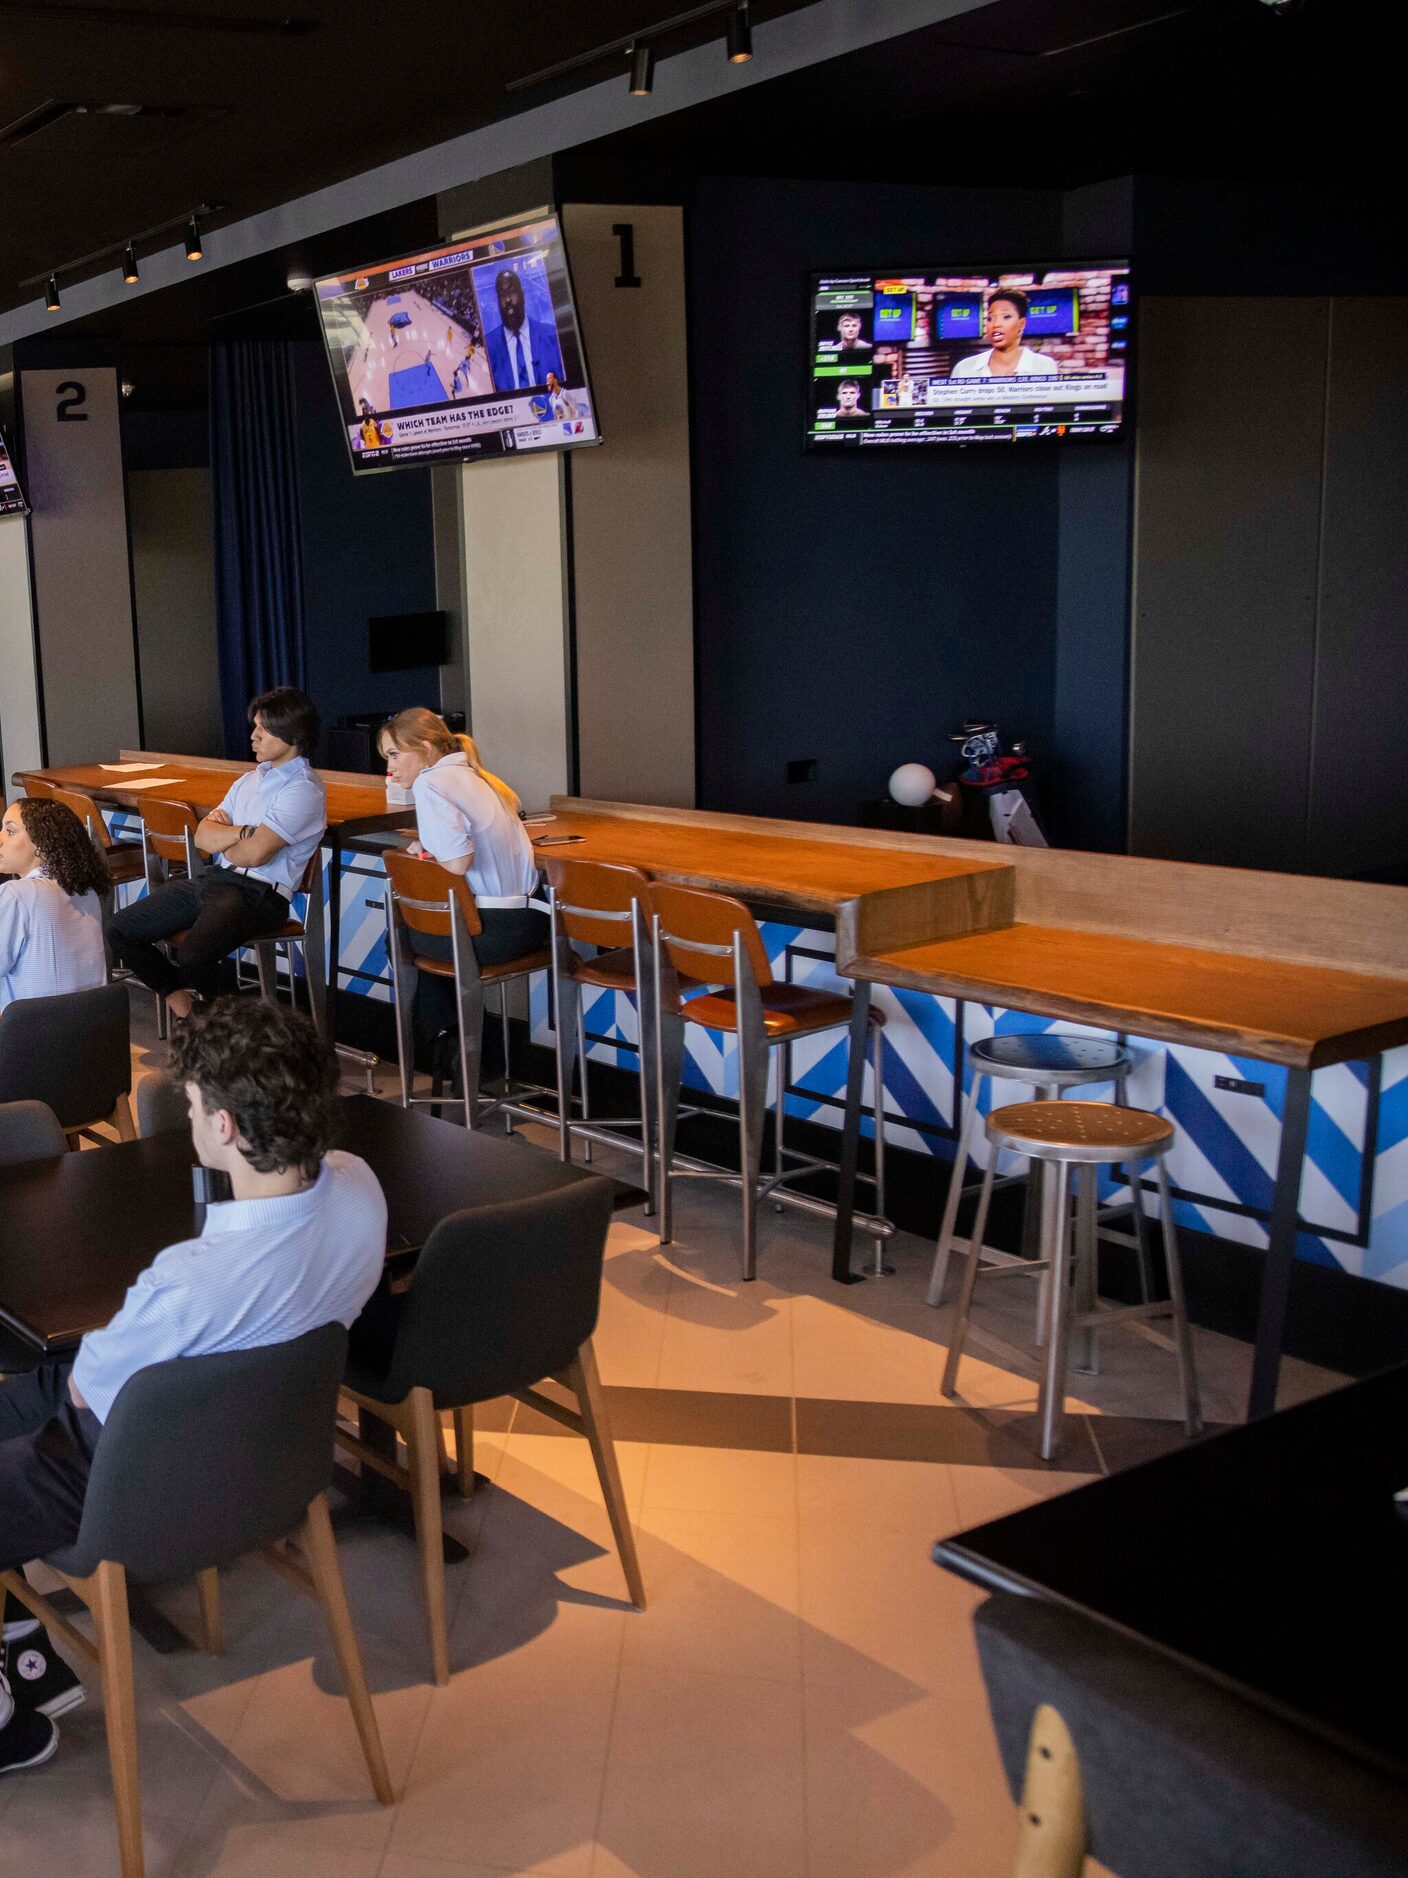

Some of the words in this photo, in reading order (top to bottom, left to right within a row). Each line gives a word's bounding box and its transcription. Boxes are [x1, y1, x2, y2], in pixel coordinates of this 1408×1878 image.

[391, 267, 413, 279] LAKERS
[431, 252, 471, 268] WARRIORS
[612, 224, 641, 288] 1
[1029, 305, 1045, 315] GET
[1046, 304, 1057, 314] UP
[55, 381, 88, 421] 2
[932, 388, 958, 396] Stephen
[396, 419, 424, 431] WHICH
[425, 415, 448, 426] TEAM
[450, 411, 467, 422] HAS
[468, 408, 485, 420] THE
[487, 405, 514, 417] EDGE?
